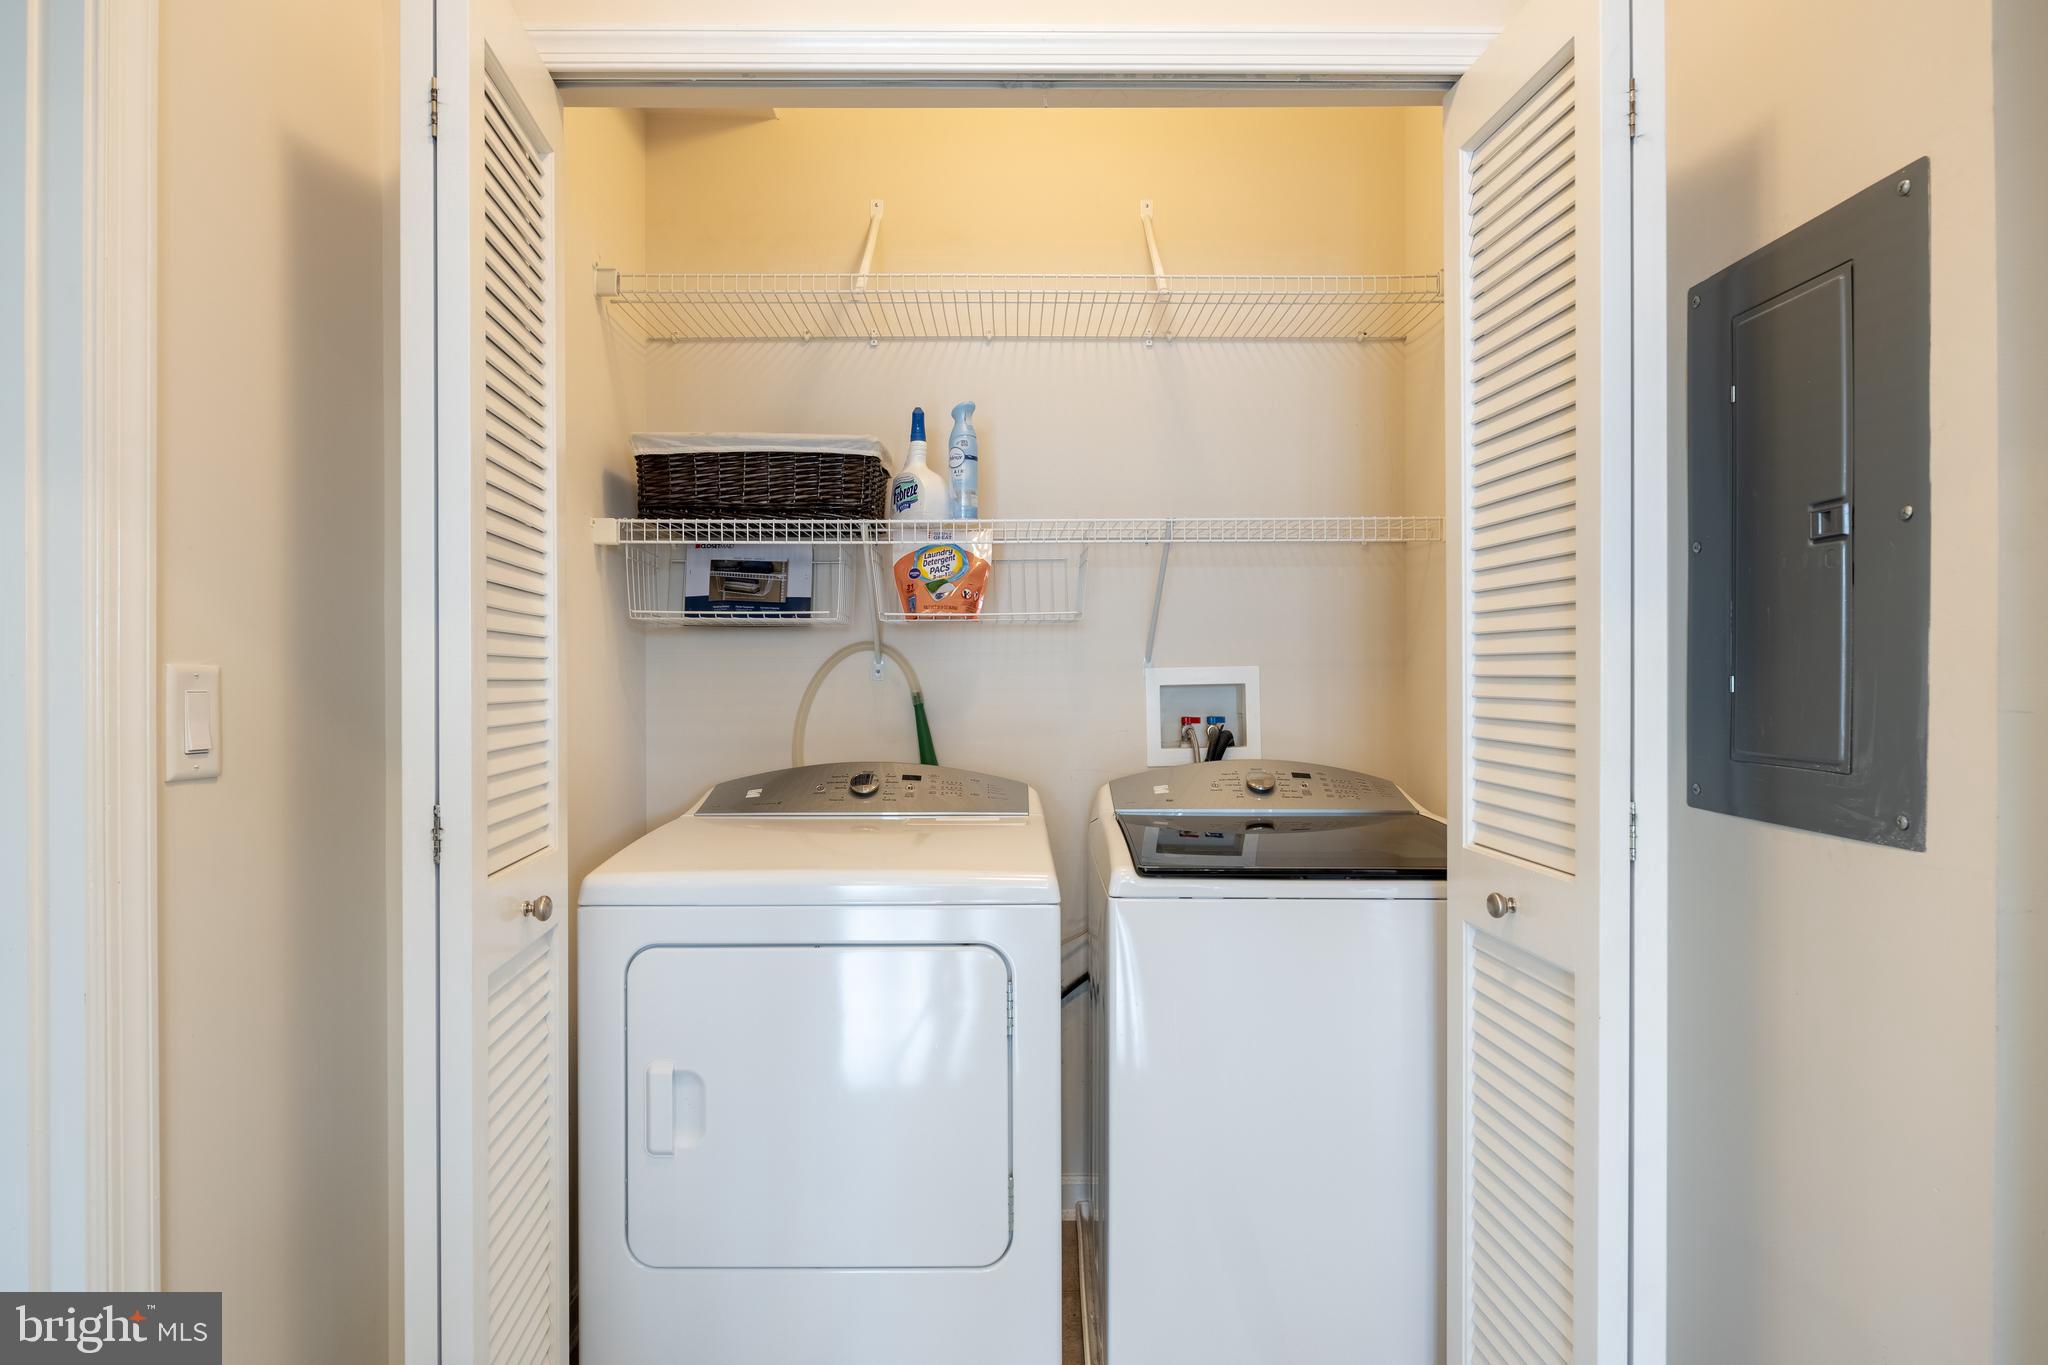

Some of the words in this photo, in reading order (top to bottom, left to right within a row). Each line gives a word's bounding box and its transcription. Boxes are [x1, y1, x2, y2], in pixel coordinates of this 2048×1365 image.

[893, 483, 919, 505] Febreze
[924, 549, 953, 559] Laundry
[923, 554, 956, 567] Detergent
[929, 564, 951, 574] PACS
